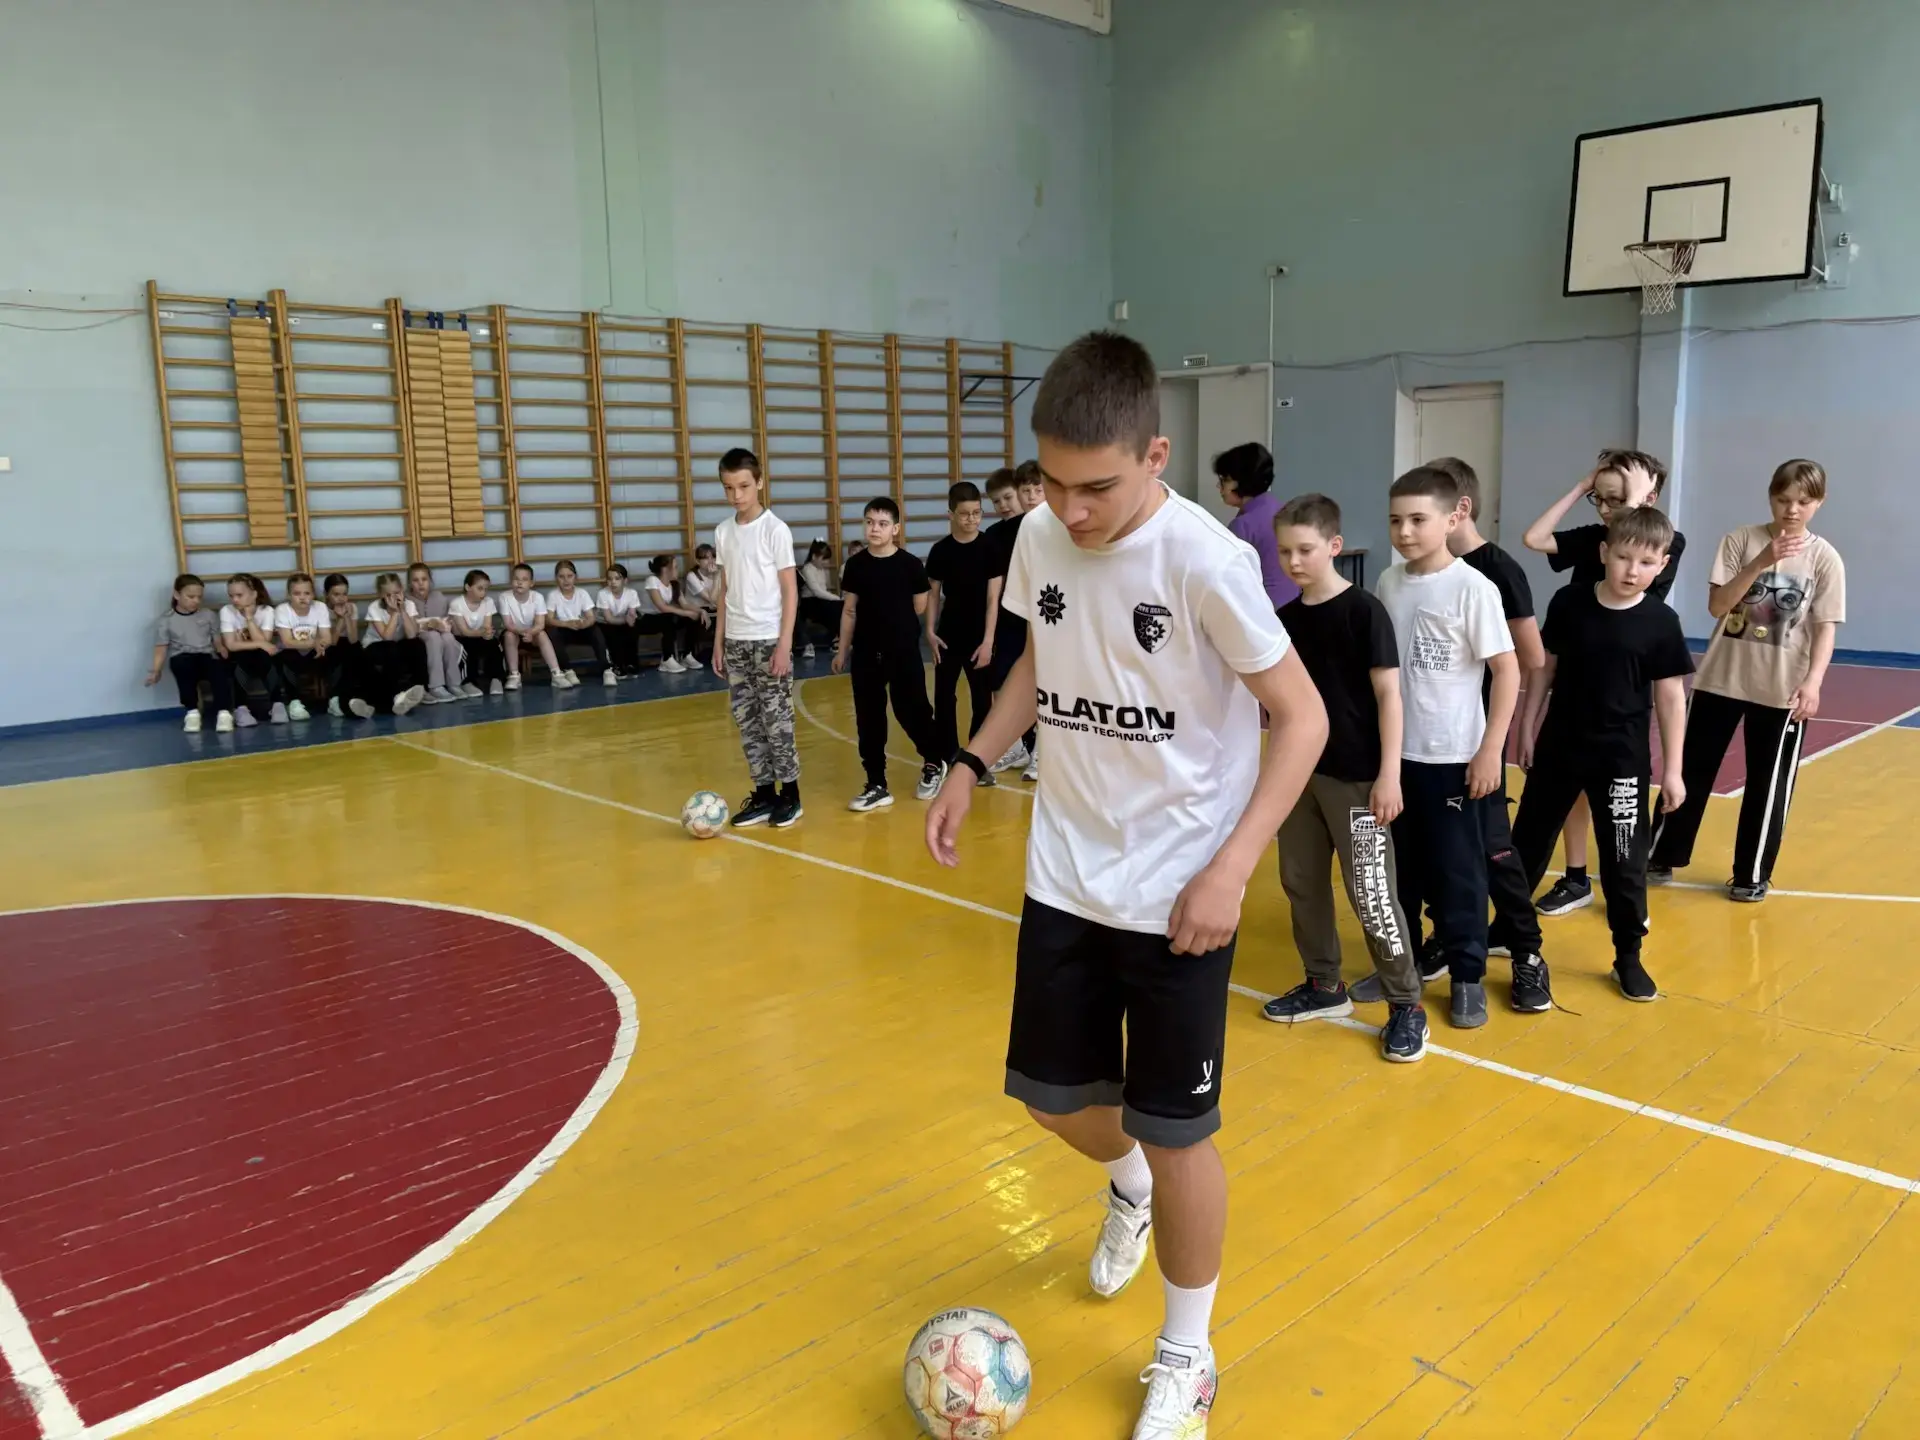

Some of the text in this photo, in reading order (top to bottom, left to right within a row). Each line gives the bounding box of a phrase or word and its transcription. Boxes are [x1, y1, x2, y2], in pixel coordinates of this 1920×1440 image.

[1036, 686, 1175, 731] PLATON
[1092, 725, 1175, 743] TECHNOLOGY
[1364, 865, 1386, 939] REALITY
[1374, 833, 1404, 956] ALTERNATIVE
